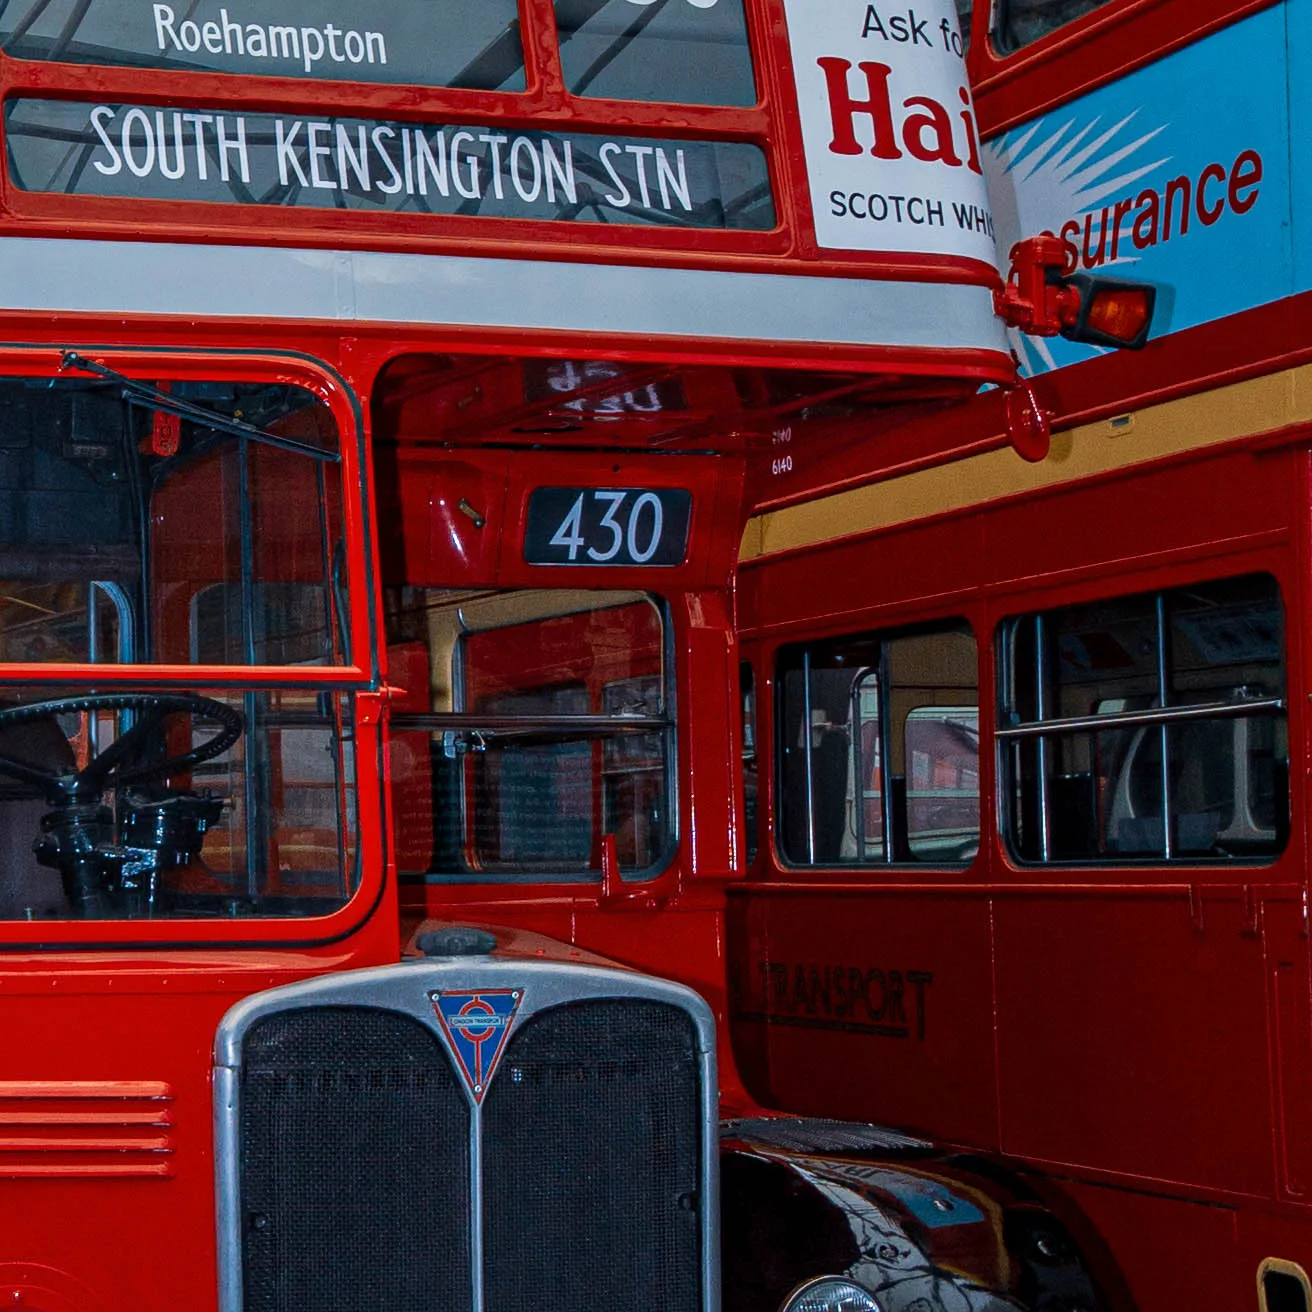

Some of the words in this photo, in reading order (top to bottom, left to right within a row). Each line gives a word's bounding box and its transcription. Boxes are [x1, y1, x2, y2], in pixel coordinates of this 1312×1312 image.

[153, 3, 387, 73] Roehampton
[861, 4, 933, 48] Ask
[90, 105, 250, 184] SOUTH
[276, 119, 576, 204] KENSINGTON
[599, 141, 693, 211] STN
[830, 190, 944, 226] SCOTCH
[549, 491, 663, 563] 430
